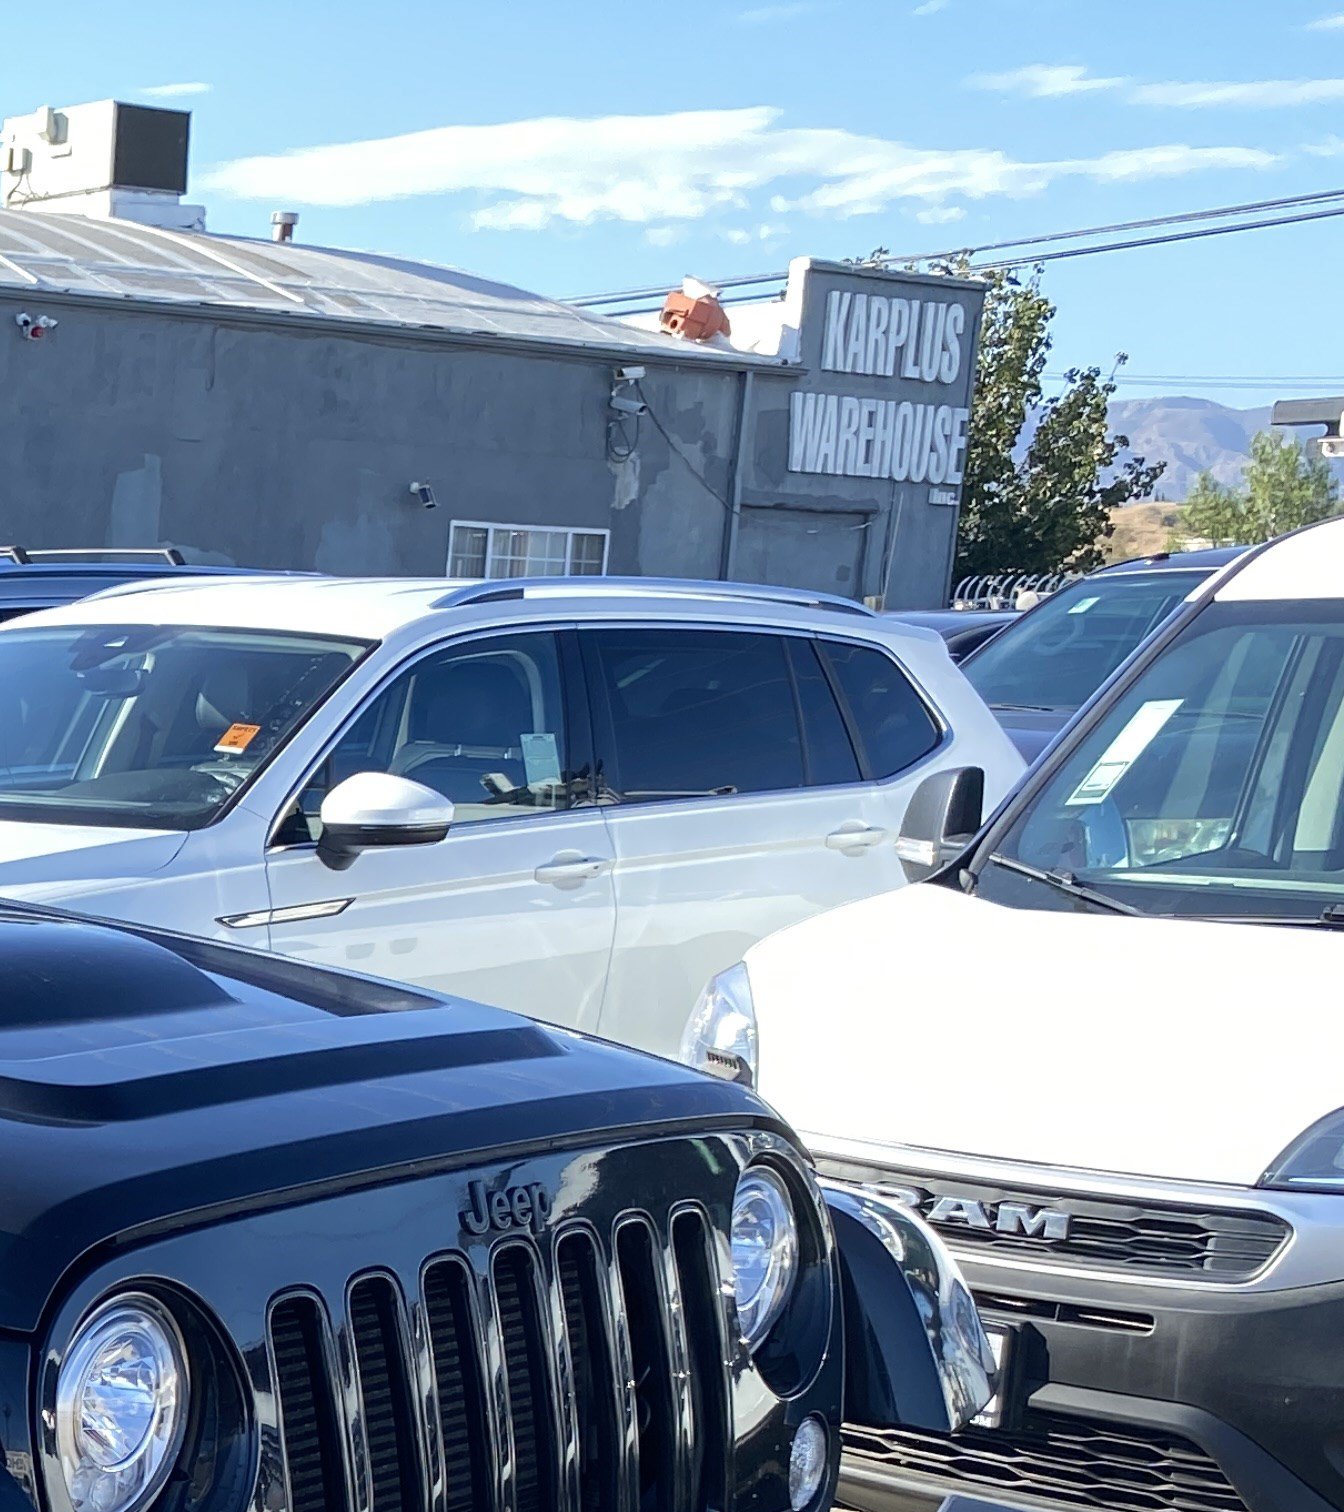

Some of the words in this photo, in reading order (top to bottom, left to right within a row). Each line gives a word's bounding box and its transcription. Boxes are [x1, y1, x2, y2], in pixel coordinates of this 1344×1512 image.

[822, 291, 964, 384] KARPLUS
[788, 392, 969, 485] WAREHOUSE
[459, 1180, 552, 1235] Jeep
